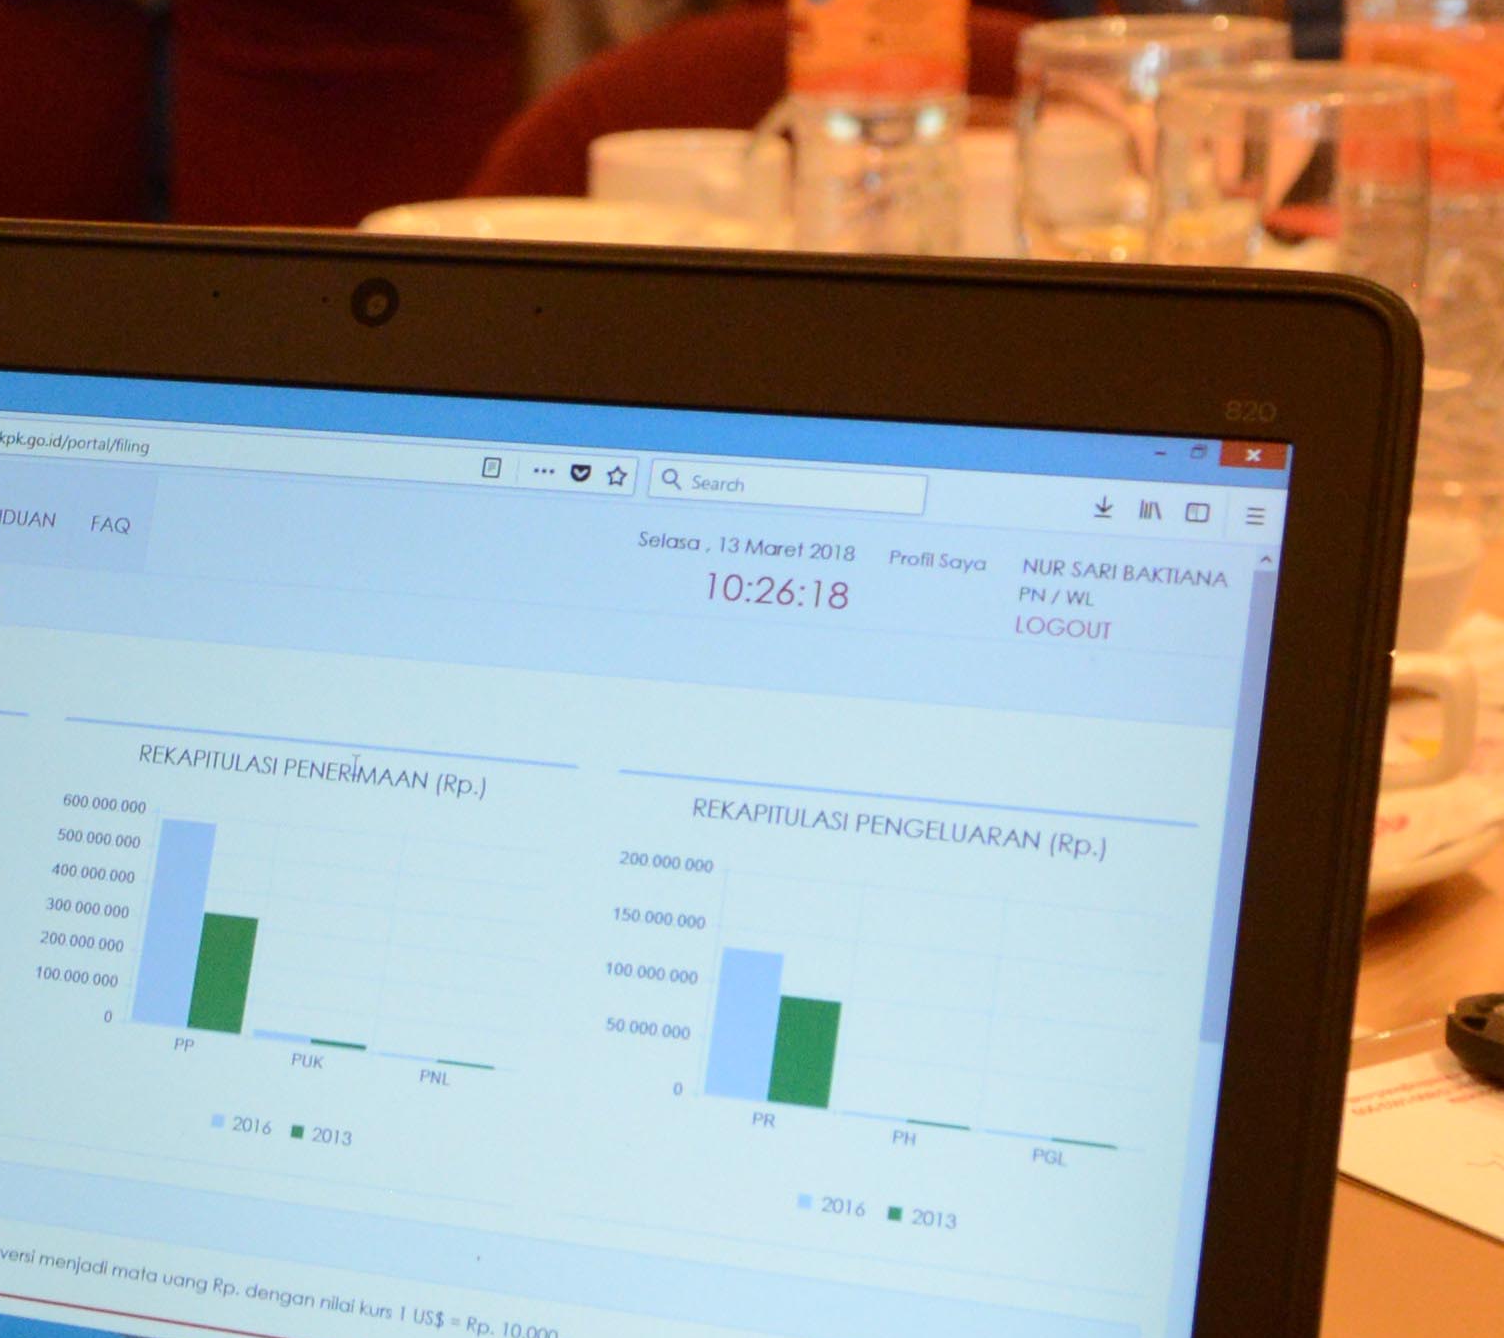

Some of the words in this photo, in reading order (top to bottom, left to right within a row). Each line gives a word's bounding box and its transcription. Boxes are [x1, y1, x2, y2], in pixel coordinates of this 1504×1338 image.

[1225, 399, 1278, 424] 820
[692, 473, 745, 494] Search
[91, 515, 131, 536] FAQ
[638, 531, 700, 553] Selasa
[718, 534, 739, 554] 13
[743, 535, 803, 560] Maret
[809, 542, 856, 563] 2018
[890, 547, 934, 569] Profil
[939, 551, 988, 575] Saya
[1022, 557, 1065, 578] NUR
[1070, 560, 1118, 582] SARI
[1122, 563, 1229, 590] BAKTIANA
[705, 570, 850, 611] 10:26:18
[1018, 585, 1047, 604] PN
[1065, 588, 1095, 607] WL
[1014, 615, 1112, 641] LOGOUT
[139, 744, 279, 776] REKAPITULASI
[284, 756, 428, 790] PENERIMAAN
[435, 771, 488, 801] (Rp.)
[692, 797, 849, 833] REKAPITULASI
[855, 812, 1042, 851] PENGELUARAN
[1049, 832, 1108, 862] (Rp.)
[174, 1037, 195, 1052] PP
[291, 1052, 323, 1069] PUK
[419, 1069, 451, 1086] PNL
[232, 1115, 272, 1136] 2016
[752, 1112, 775, 1129] PR
[312, 1126, 353, 1146] 2013
[892, 1130, 917, 1148] PH
[1032, 1148, 1067, 1167] PGL
[821, 1194, 866, 1218] 2016
[912, 1207, 957, 1230] 2013
[39, 1251, 108, 1279] menjadi
[112, 1265, 158, 1285] mata
[162, 1272, 208, 1296] uang
[213, 1277, 241, 1300] Rp.
[245, 1282, 316, 1312] dengan
[320, 1294, 356, 1316] nilai
[359, 1300, 394, 1322] kurs
[412, 1308, 446, 1330] US$
[465, 1316, 495, 1338] Rp.
